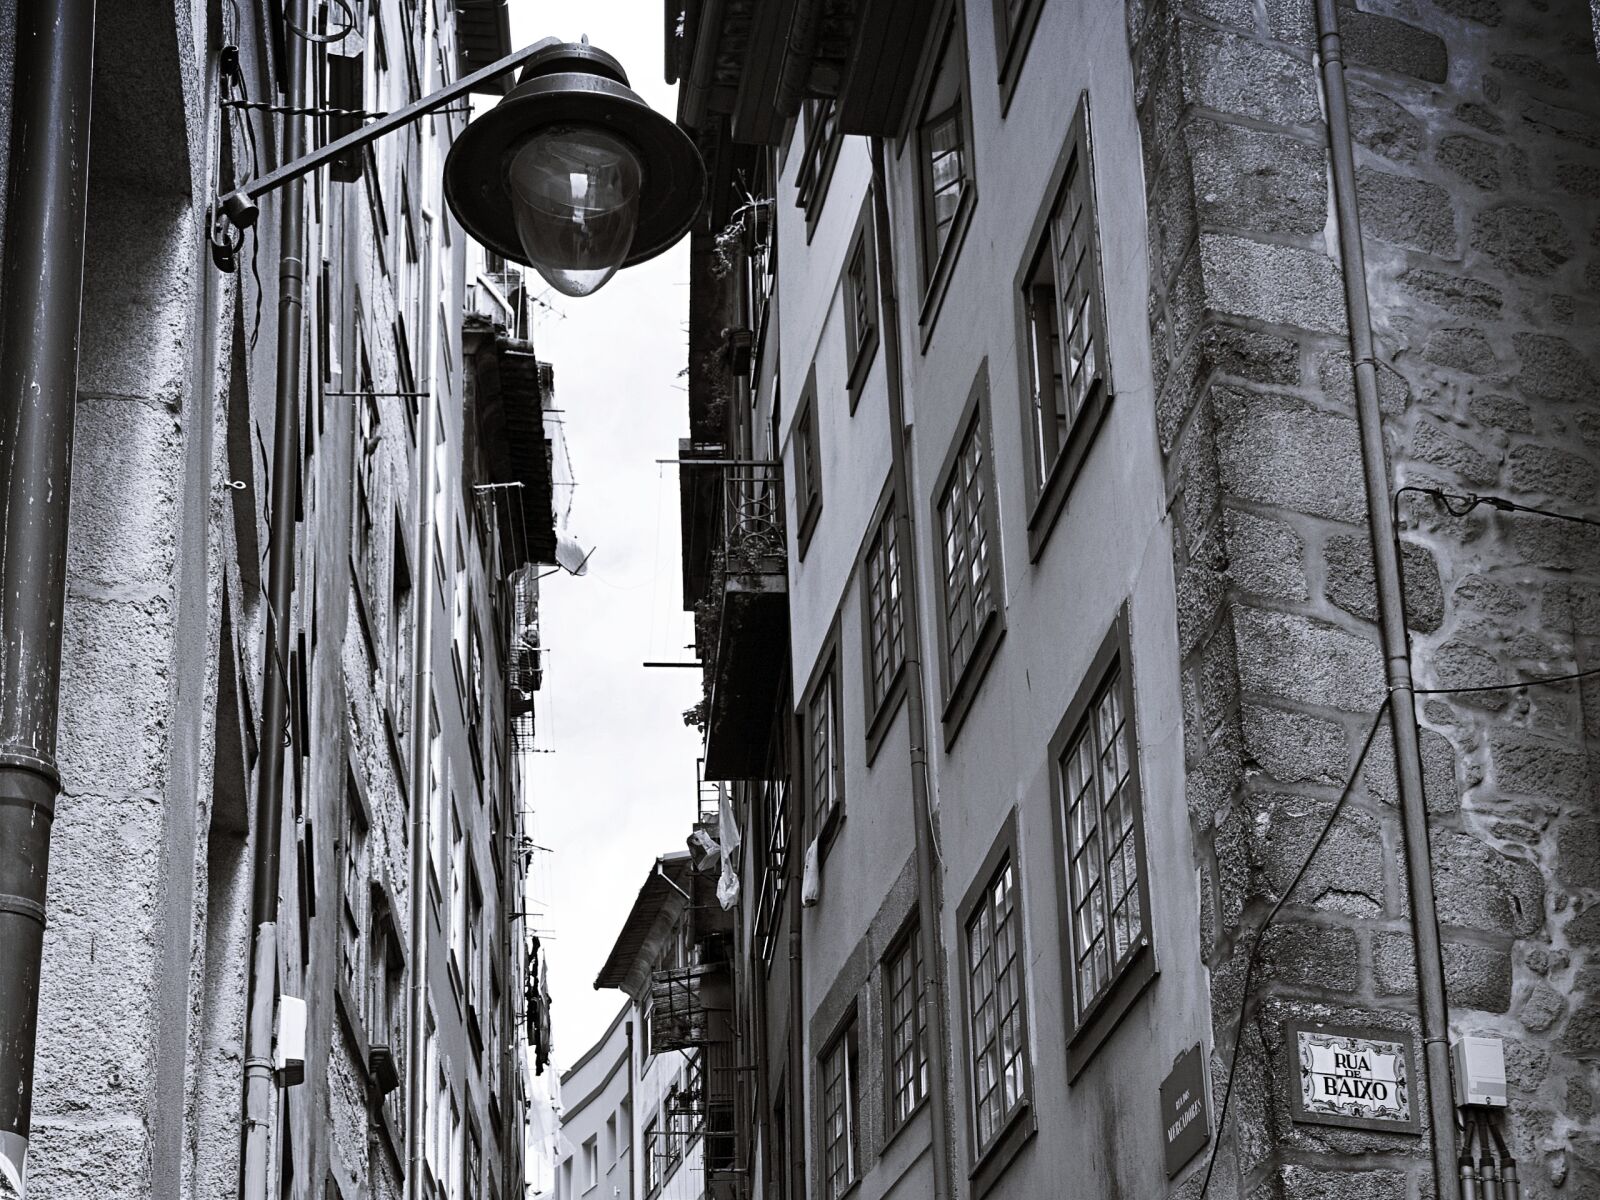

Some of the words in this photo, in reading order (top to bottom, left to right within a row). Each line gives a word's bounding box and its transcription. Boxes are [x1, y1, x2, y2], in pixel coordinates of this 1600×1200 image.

[1335, 1053, 1371, 1072] RUA
[1345, 1069, 1362, 1079] DE
[1323, 1076, 1388, 1101] BAIXO
[1167, 1098, 1202, 1143] MERCADORES
